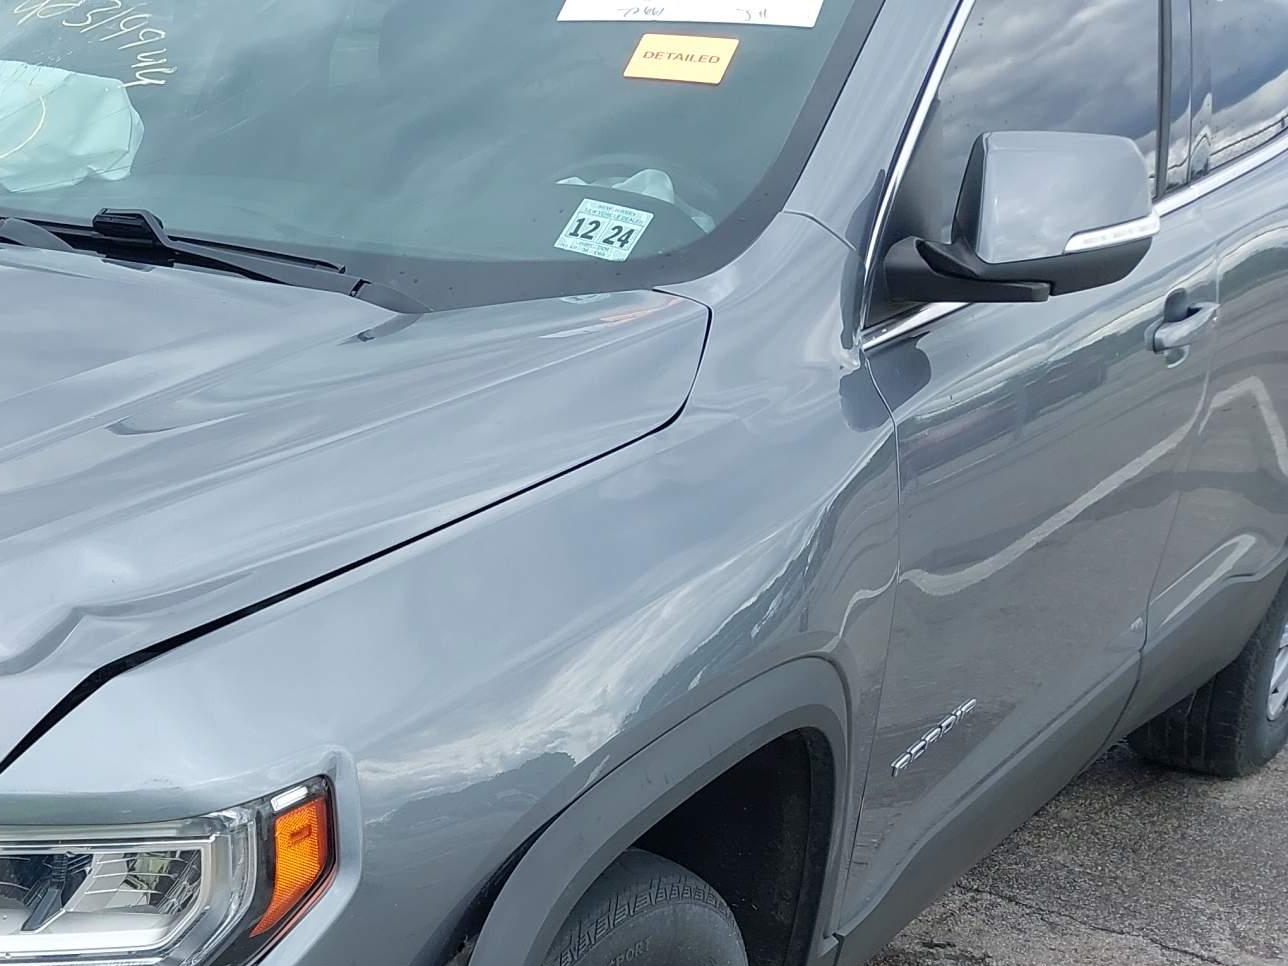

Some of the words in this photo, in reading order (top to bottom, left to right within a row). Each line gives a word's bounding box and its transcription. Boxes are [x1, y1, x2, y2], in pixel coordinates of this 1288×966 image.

[642, 50, 721, 65] DETAILED
[568, 218, 601, 241] 12
[602, 225, 635, 248] 24
